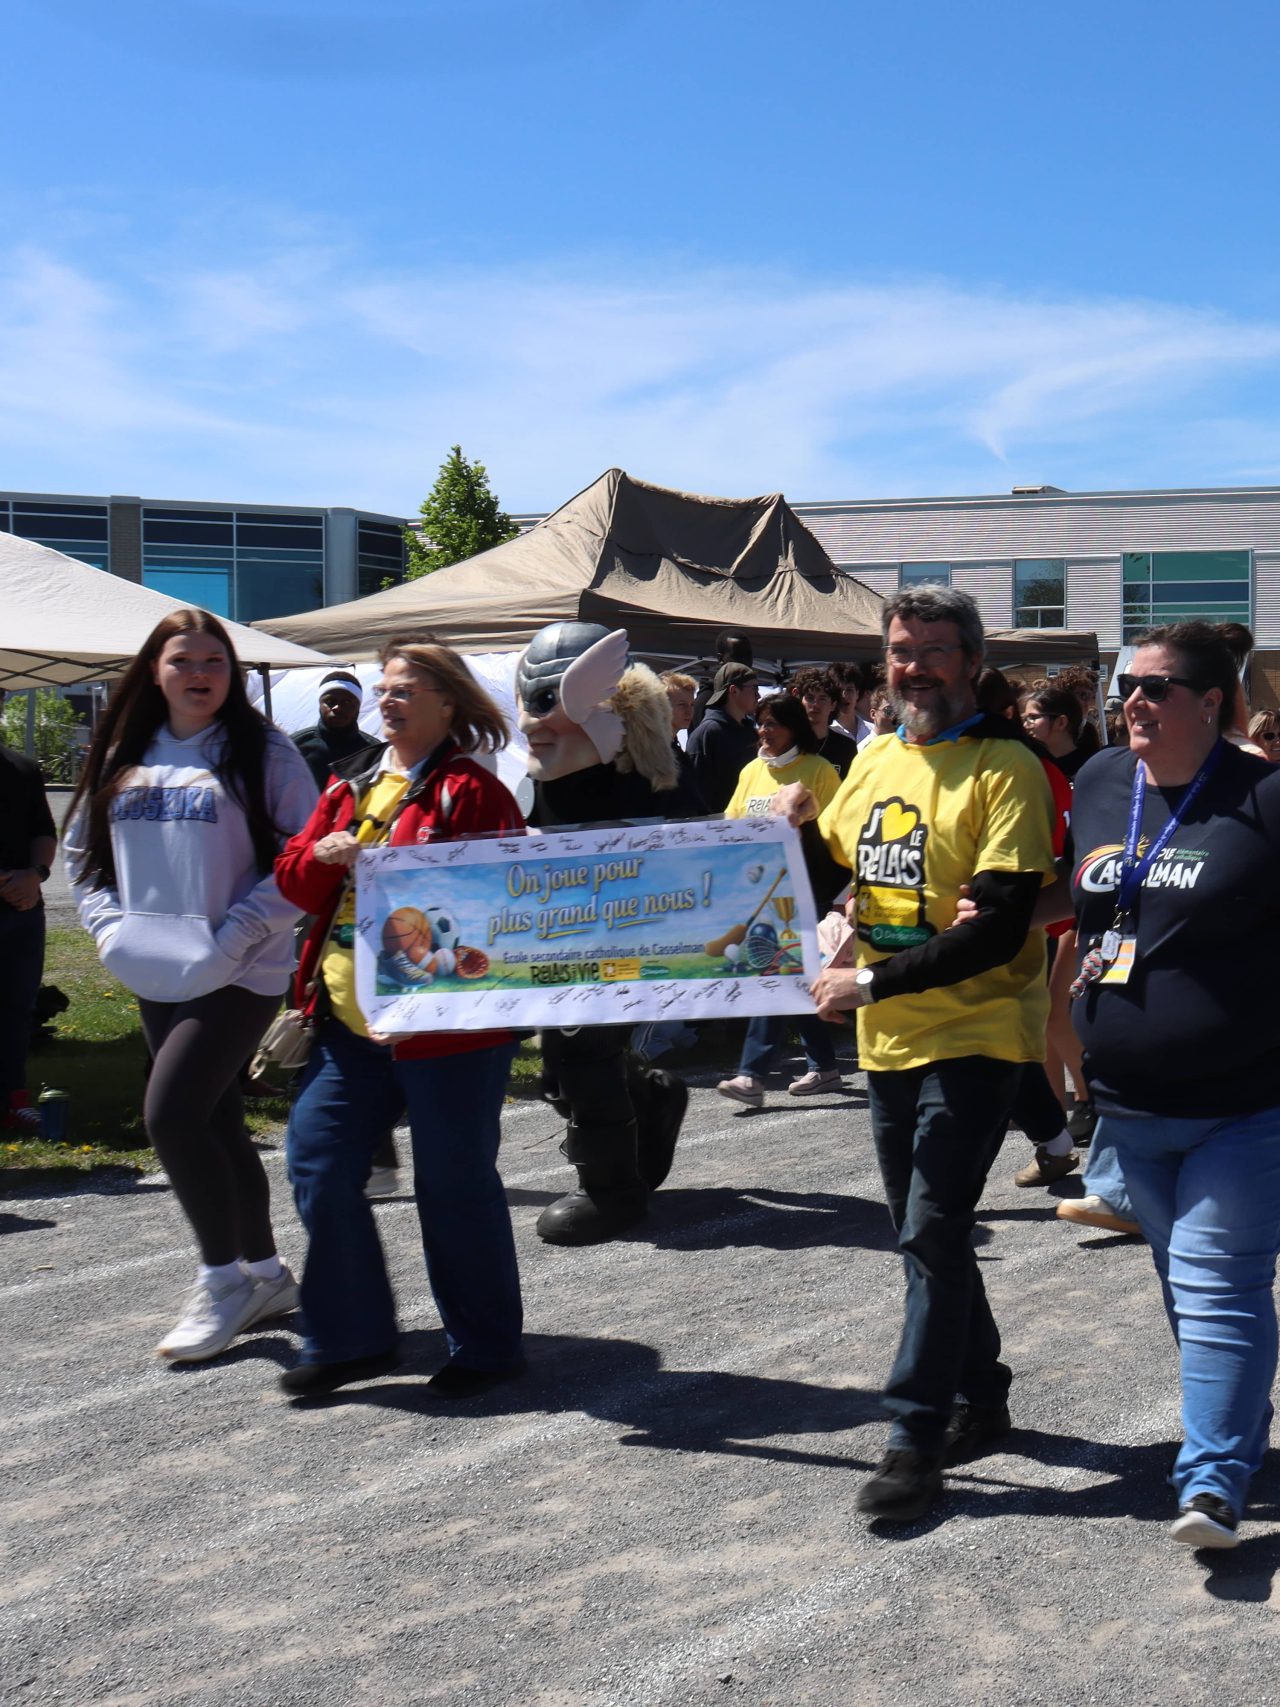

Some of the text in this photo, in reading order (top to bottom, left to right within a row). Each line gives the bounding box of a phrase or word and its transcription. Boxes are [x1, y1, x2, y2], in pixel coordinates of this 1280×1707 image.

[909, 829, 924, 847] LE
[507, 857, 644, 904] On joue pour
[487, 907, 532, 945] plus
[536, 895, 597, 939] grand
[603, 896, 638, 929] que
[643, 888, 695, 914] nous
[639, 944, 650, 956] de
